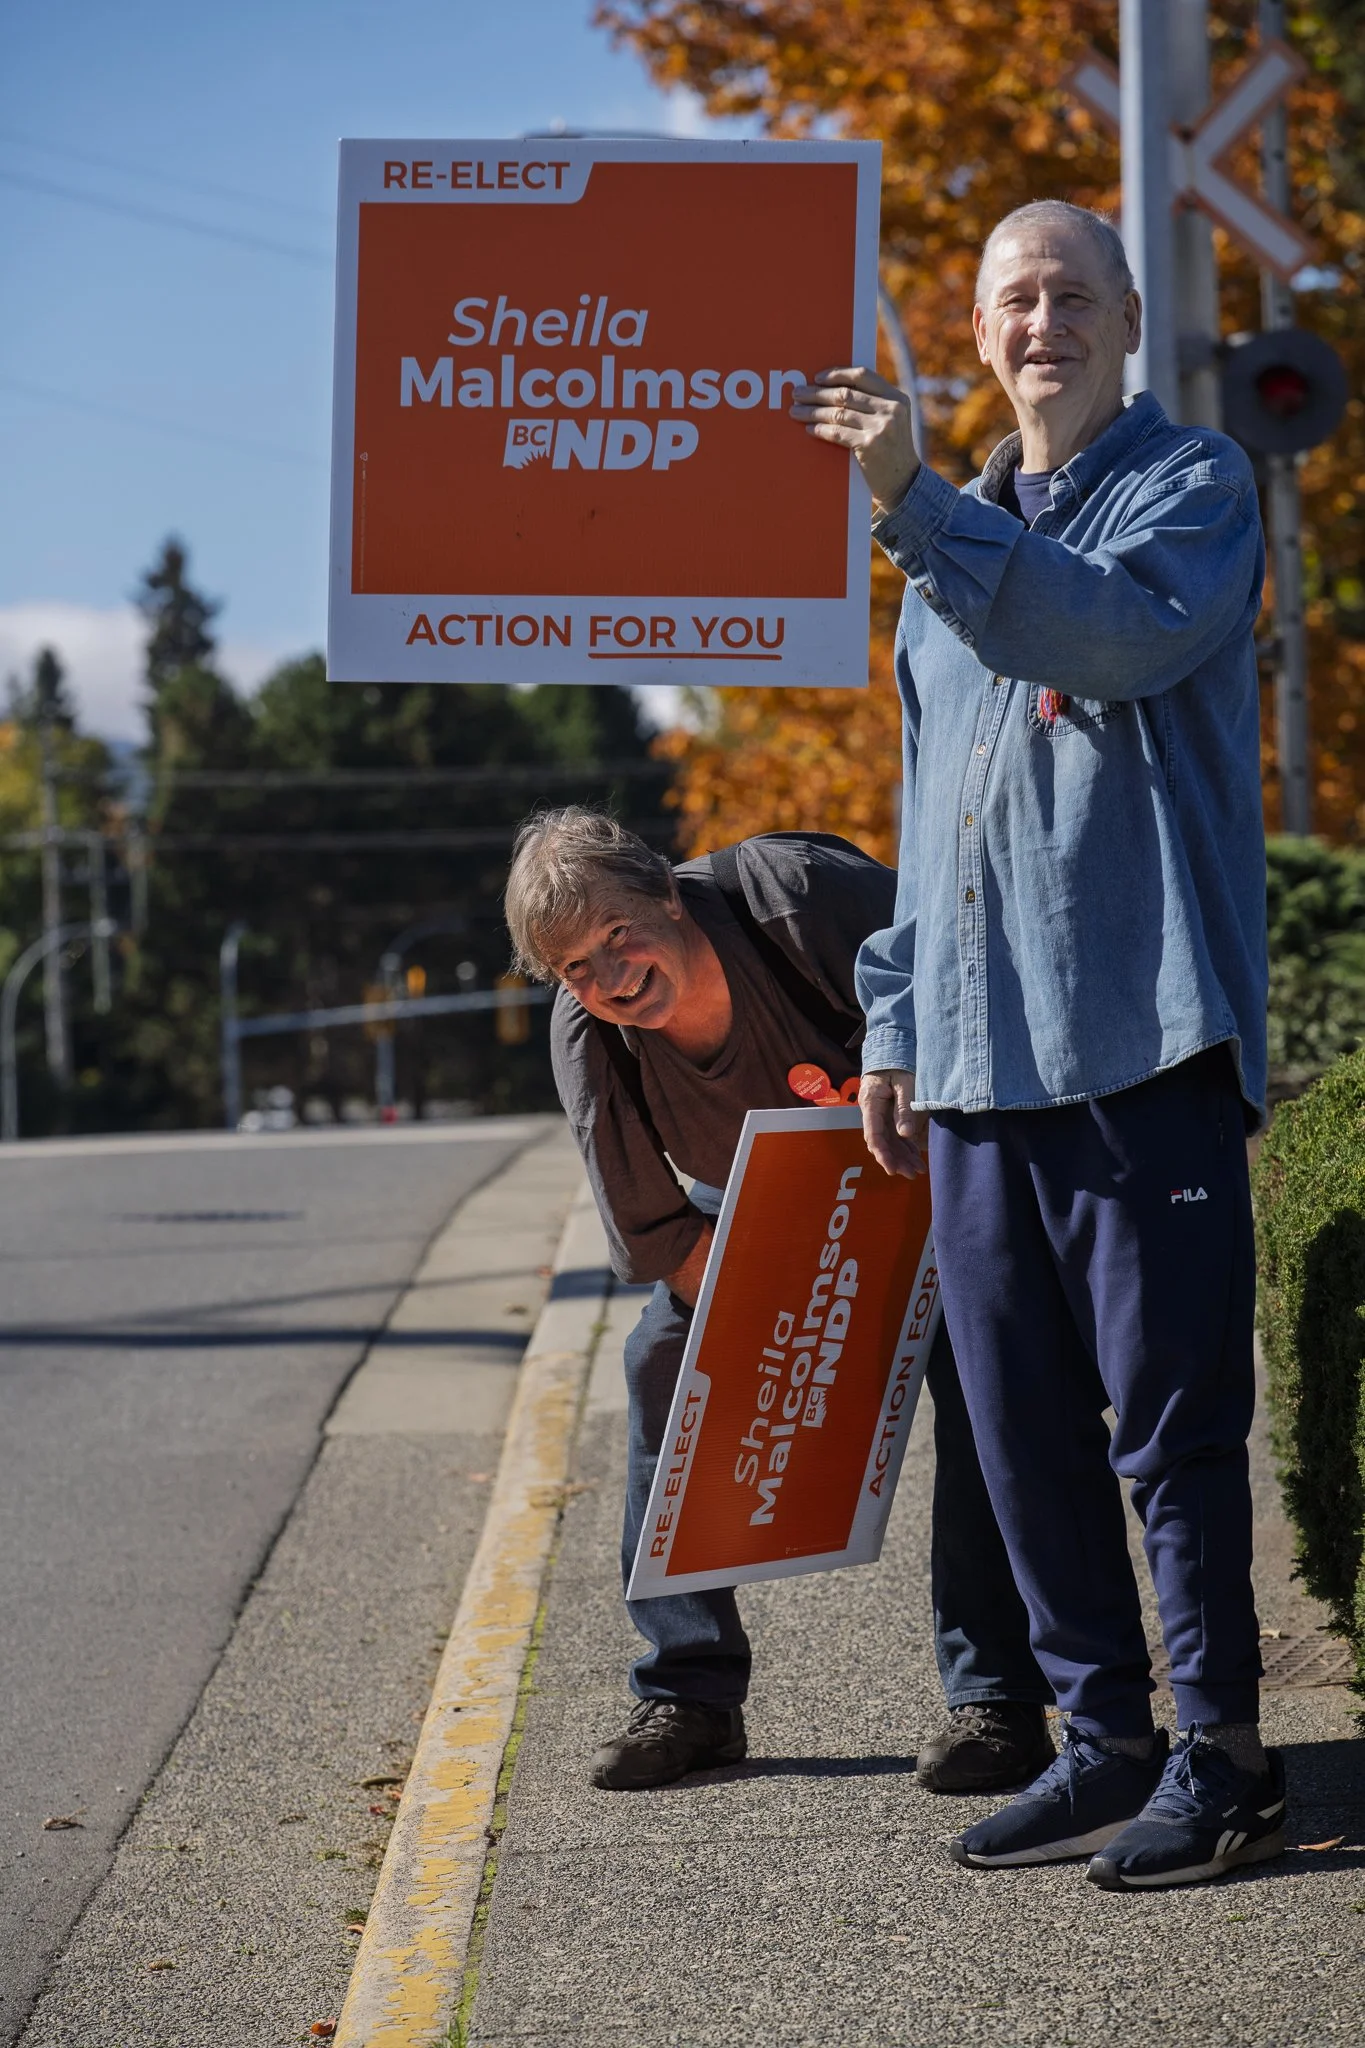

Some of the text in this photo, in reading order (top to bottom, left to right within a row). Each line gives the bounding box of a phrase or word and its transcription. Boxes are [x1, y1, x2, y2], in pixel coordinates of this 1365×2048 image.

[383, 160, 571, 190] RE-ELECT
[447, 293, 649, 347] Sheila
[399, 354, 808, 410] Malcolmson
[512, 418, 700, 471] BC NDP
[405, 613, 785, 649] ACTION FOR YOU
[1170, 1186, 1209, 1204] FILA
[749, 1166, 863, 1526] Malcolmson
[811, 1258, 859, 1386] NDP
[734, 1310, 796, 1487] Sheila
[869, 1266, 938, 1498] ACTION FOR
[649, 1389, 702, 1558] RE-ELECT
